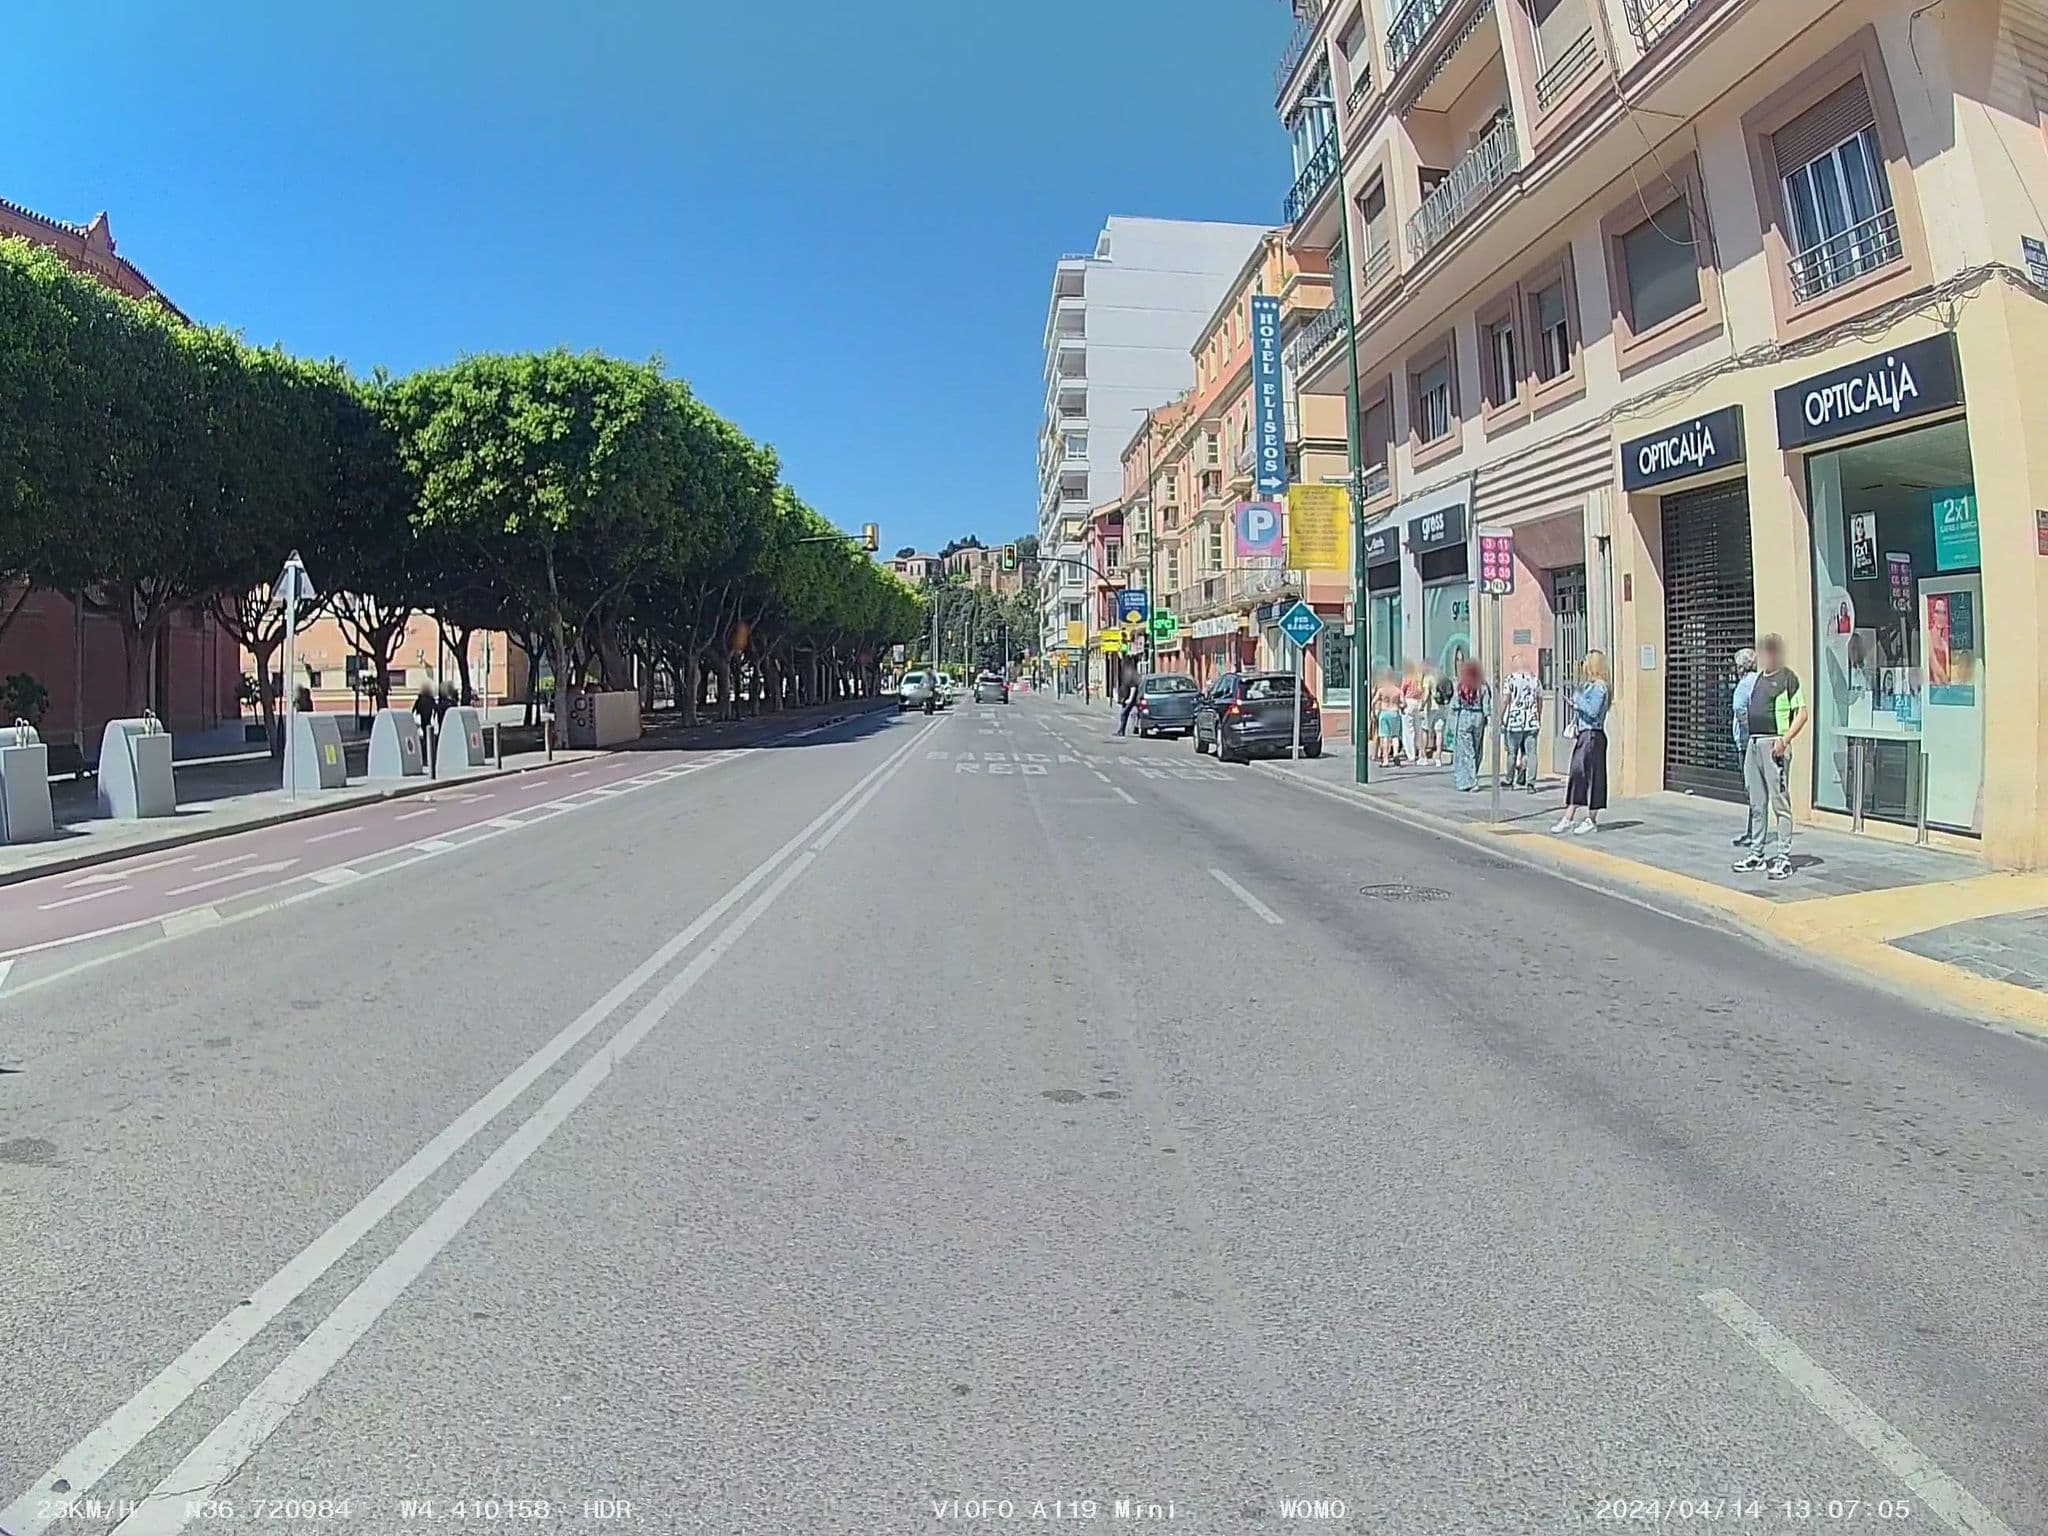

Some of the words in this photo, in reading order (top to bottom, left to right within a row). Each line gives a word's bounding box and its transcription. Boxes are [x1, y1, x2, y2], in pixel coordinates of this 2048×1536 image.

[1260, 313, 1275, 375] HOTEL
[1262, 383, 1279, 472] ELISEOS
[1248, 510, 1274, 541] P
[1943, 495, 1970, 523] 2x1
